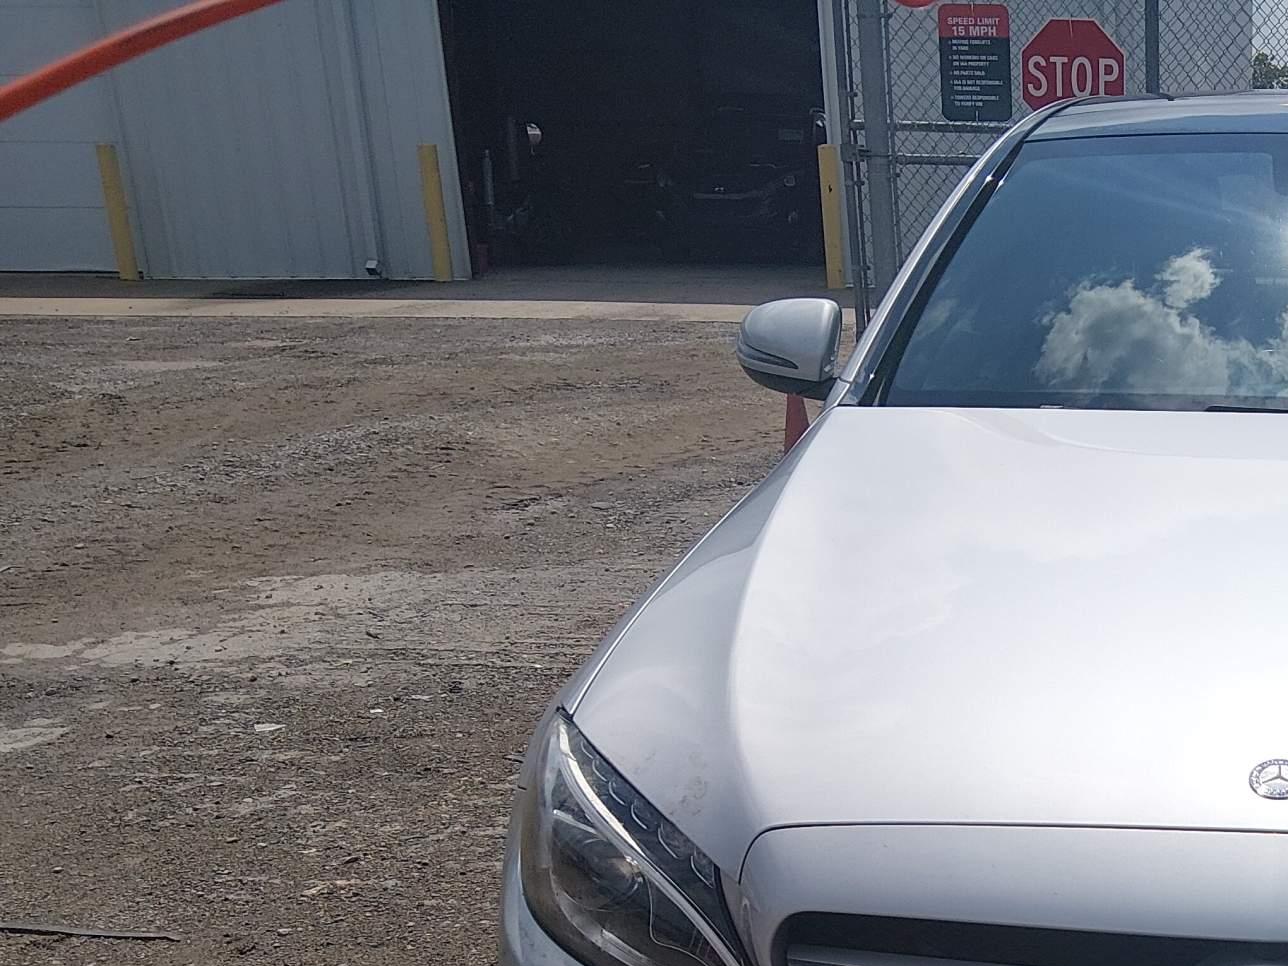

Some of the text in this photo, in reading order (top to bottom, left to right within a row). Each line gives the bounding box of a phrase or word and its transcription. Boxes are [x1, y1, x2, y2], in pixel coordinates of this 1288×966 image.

[947, 17, 1000, 25] SPEED LIMIT
[952, 26, 997, 37] 15 MPH
[1027, 55, 1120, 97] STOP
